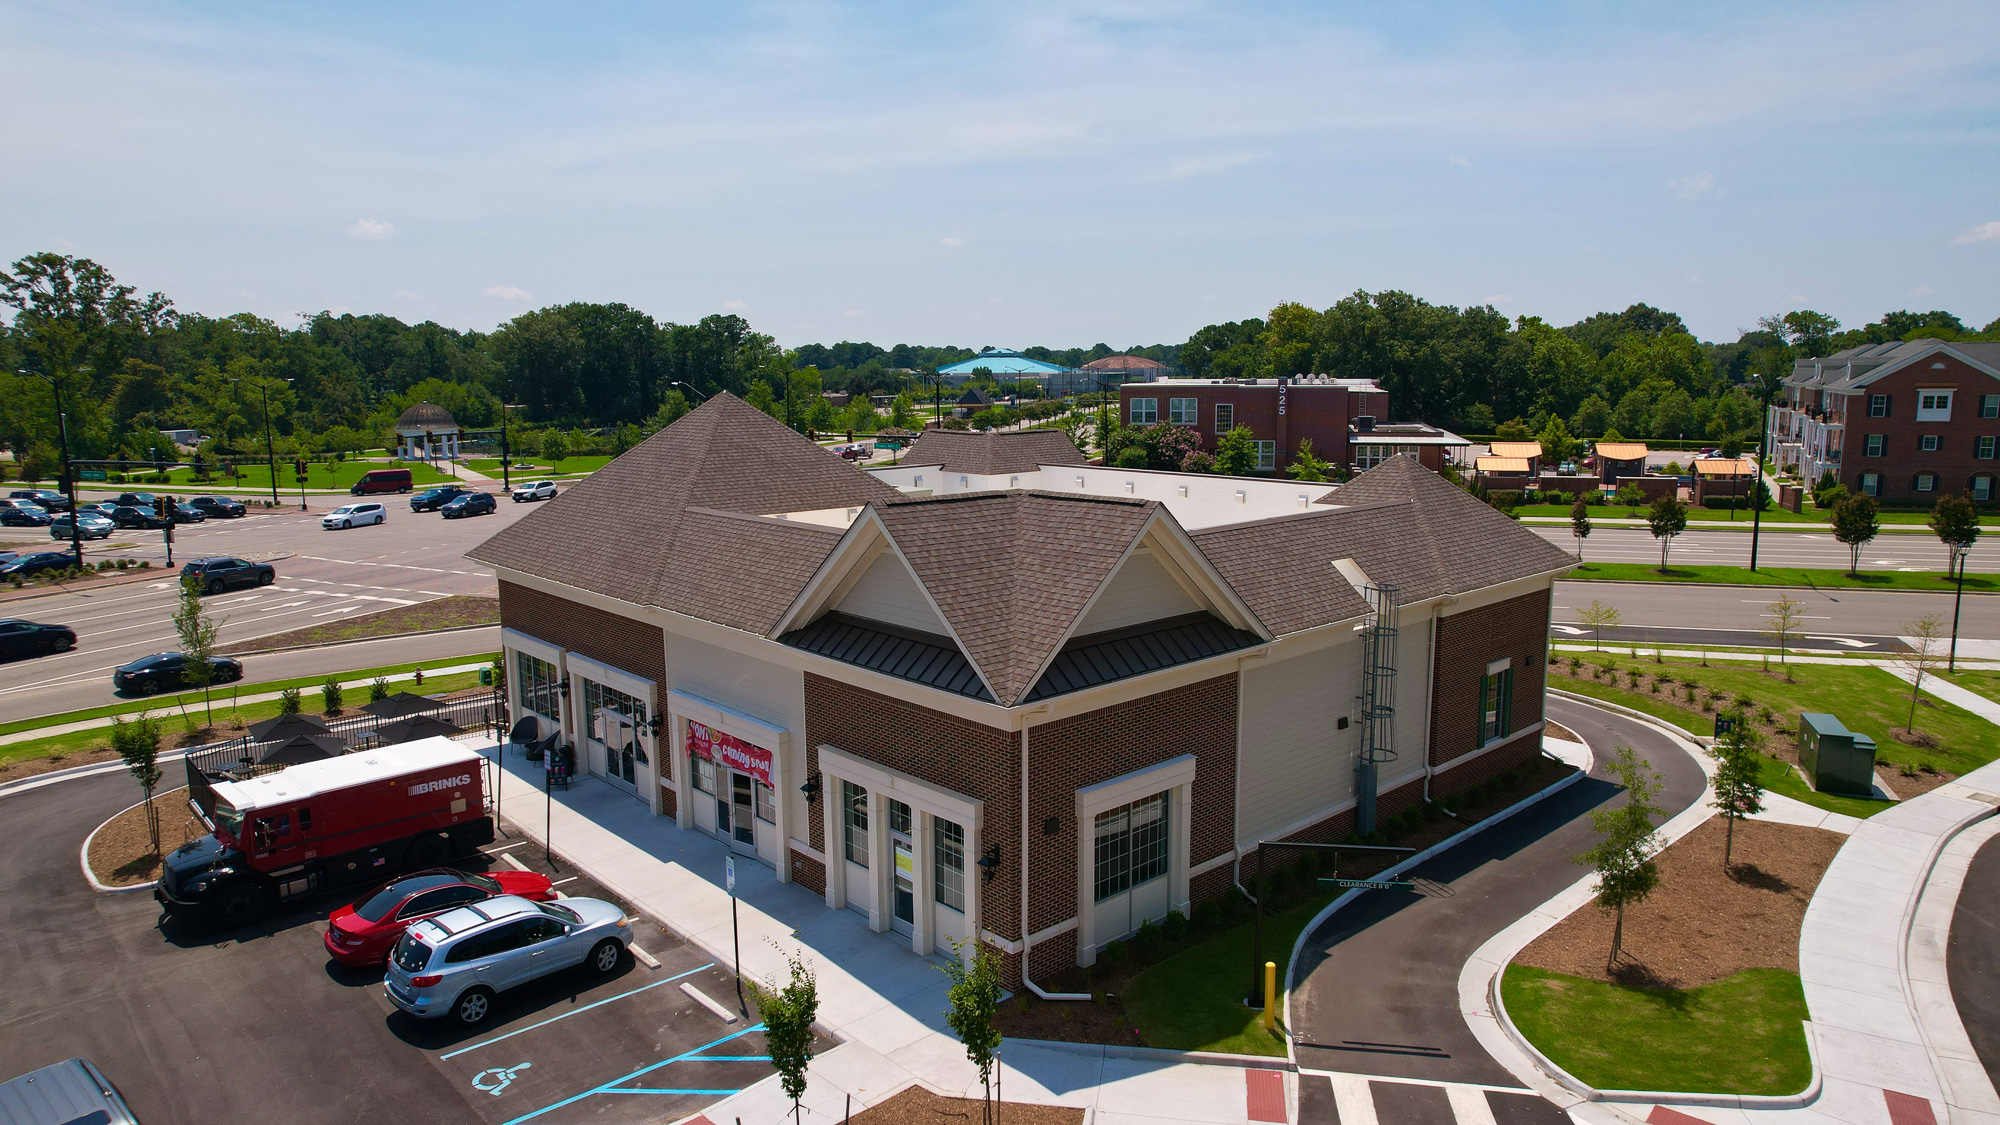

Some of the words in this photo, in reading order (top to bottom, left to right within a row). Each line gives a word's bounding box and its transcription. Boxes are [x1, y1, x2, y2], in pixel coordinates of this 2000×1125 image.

[1278, 384, 1286, 415] 525
[722, 744, 750, 769] coming
[418, 774, 471, 794] BRINKS
[1339, 881, 1377, 889] CLEARANCE
